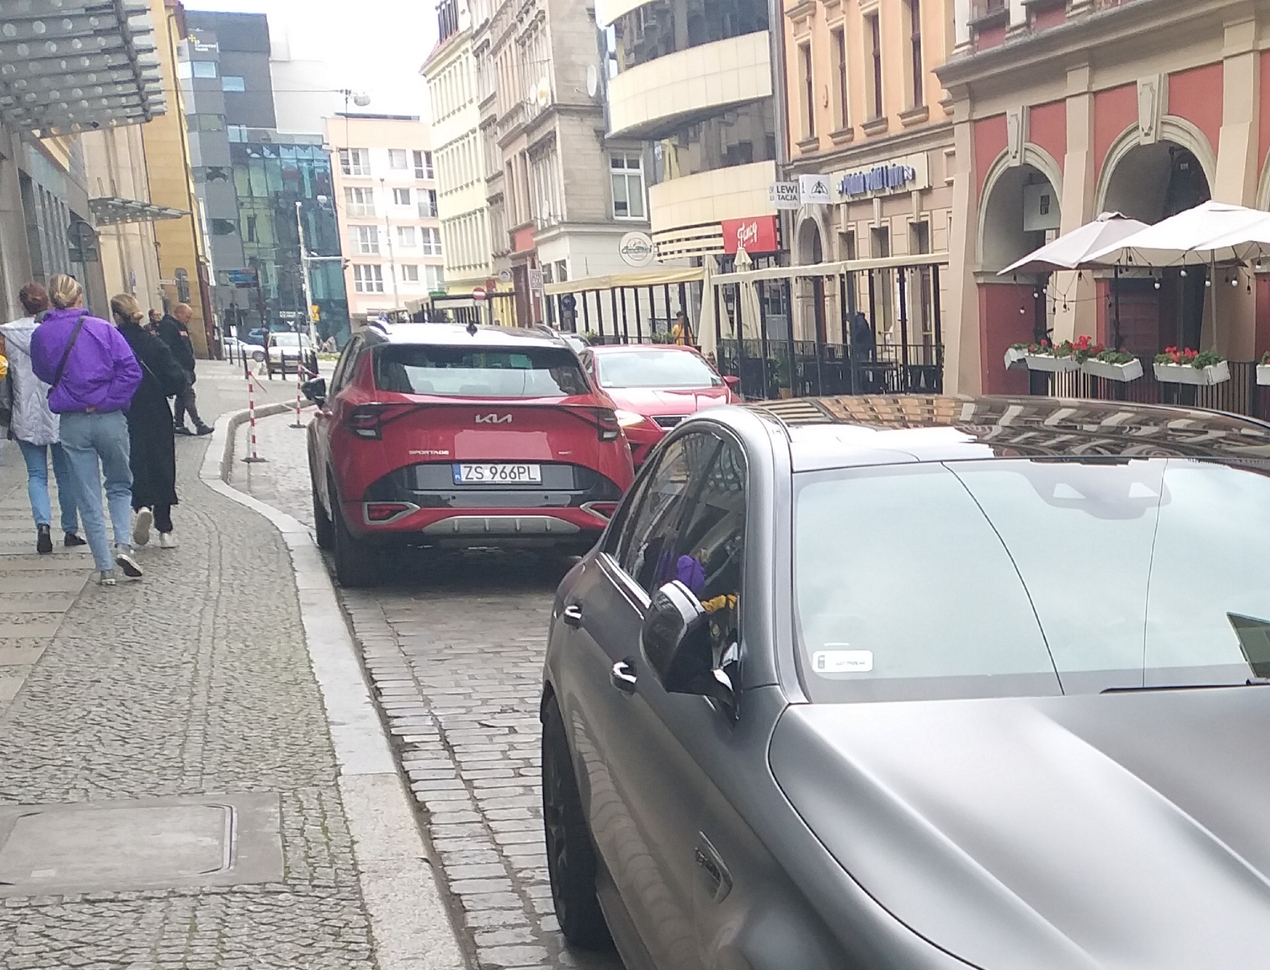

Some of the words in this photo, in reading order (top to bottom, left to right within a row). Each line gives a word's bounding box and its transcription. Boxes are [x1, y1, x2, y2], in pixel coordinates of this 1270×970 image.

[776, 184, 798, 194] LEWI
[777, 193, 798, 201] TACJA
[463, 466, 484, 480] ZS
[489, 466, 537, 480] 966PL
